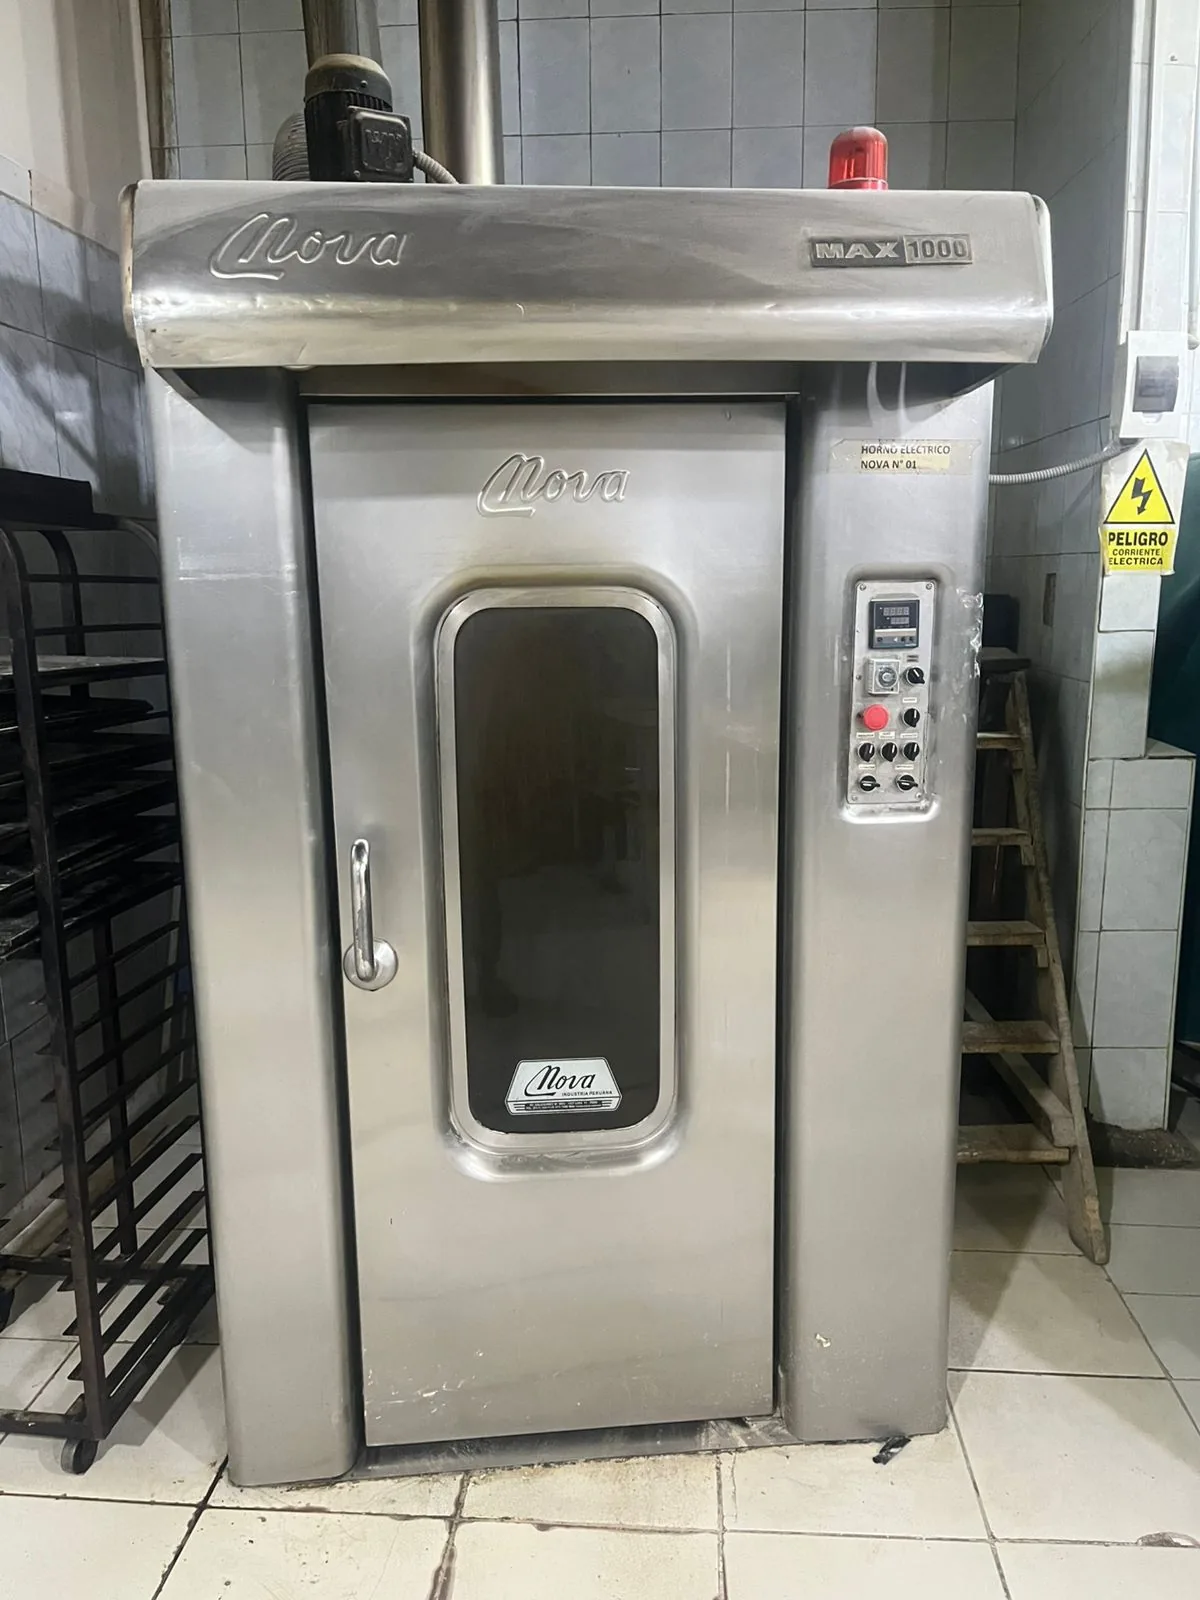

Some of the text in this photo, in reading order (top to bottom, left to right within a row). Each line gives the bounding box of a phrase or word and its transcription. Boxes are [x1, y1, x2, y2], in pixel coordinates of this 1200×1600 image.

[209, 212, 407, 281] Nova
[815, 239, 968, 259] MAX 1000
[861, 445, 951, 454] HORNO ELECTRICO
[860, 460, 890, 469] NOVA
[905, 460, 917, 469] 01
[477, 452, 631, 518] Nova
[1108, 531, 1168, 546] PELIGRO
[1112, 548, 1160, 556] CORRIENTE
[1108, 557, 1163, 565] ELECTRICA
[524, 1065, 596, 1097] Nova
